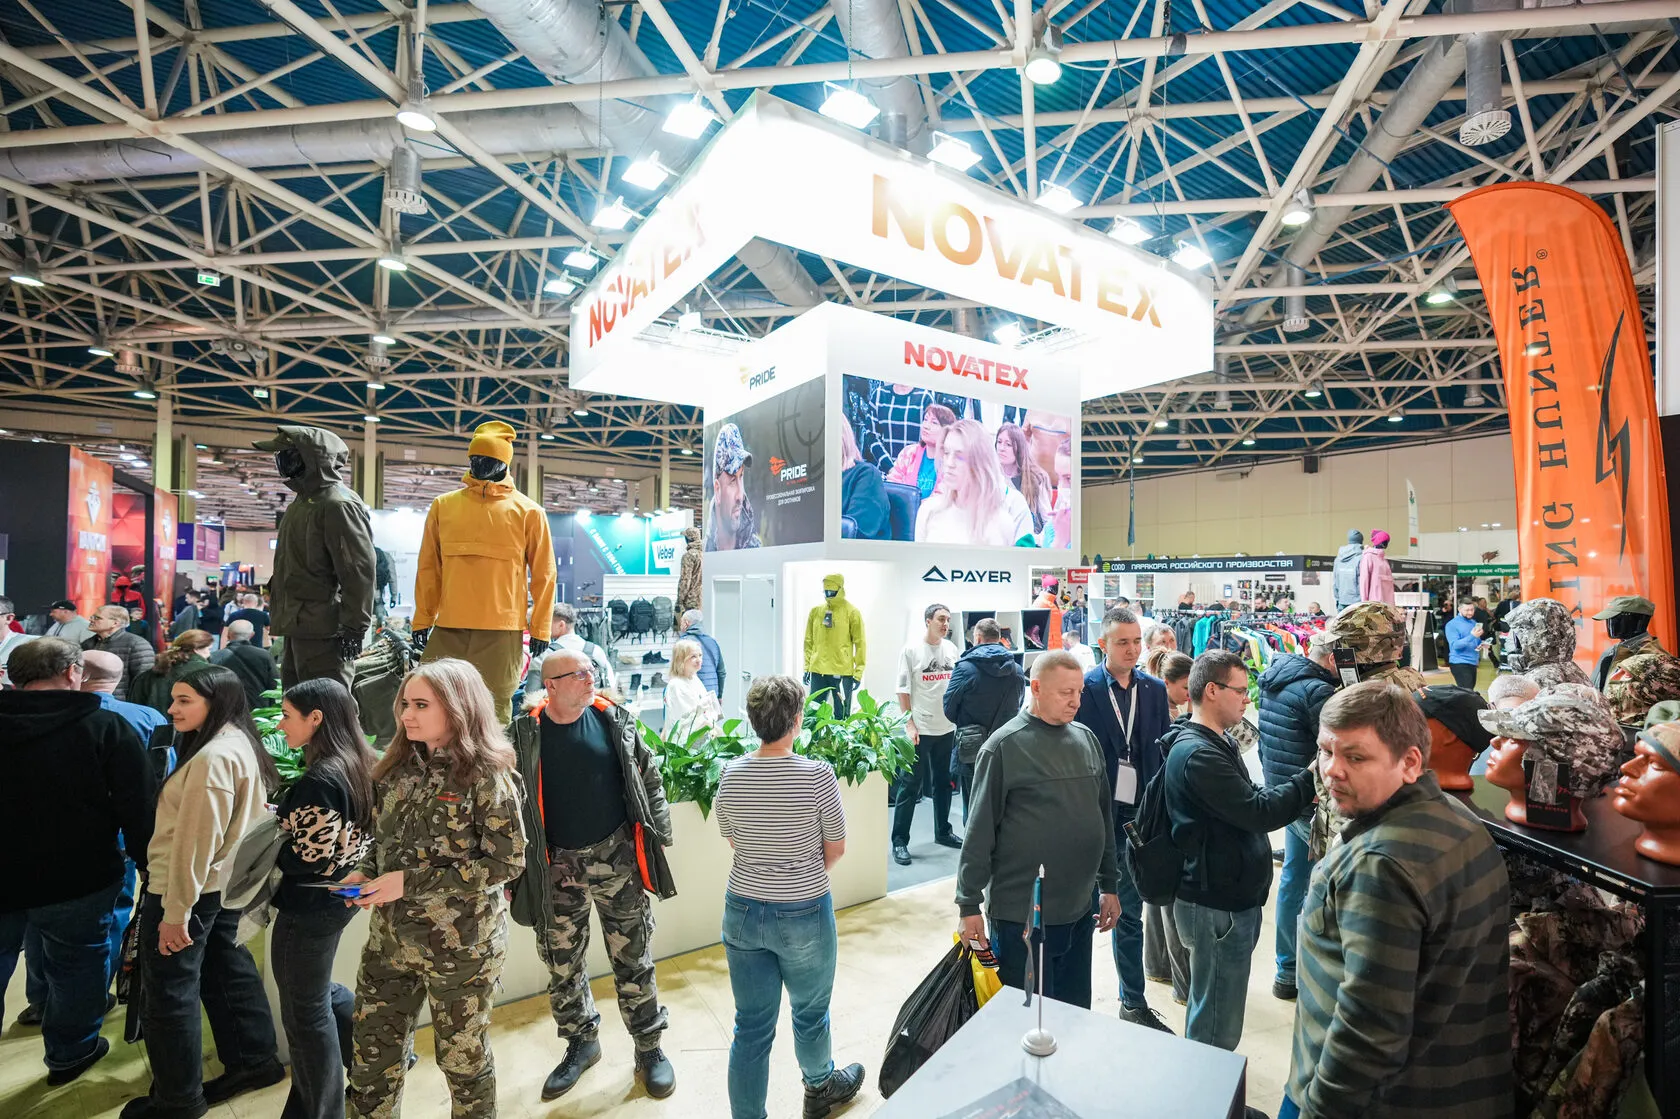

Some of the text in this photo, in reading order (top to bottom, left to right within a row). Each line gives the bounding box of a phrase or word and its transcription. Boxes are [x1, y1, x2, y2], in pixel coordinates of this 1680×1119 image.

[872, 174, 1162, 328] NOVATEX
[904, 341, 1028, 390] NOVATEX
[749, 366, 776, 391] PRIDE
[780, 464, 807, 482] PRIDE
[1170, 561, 1223, 569] РОССИЙСКОГО
[1225, 560, 1294, 568] ПРОИЗВОДСТВА
[951, 570, 1012, 583] PAYER
